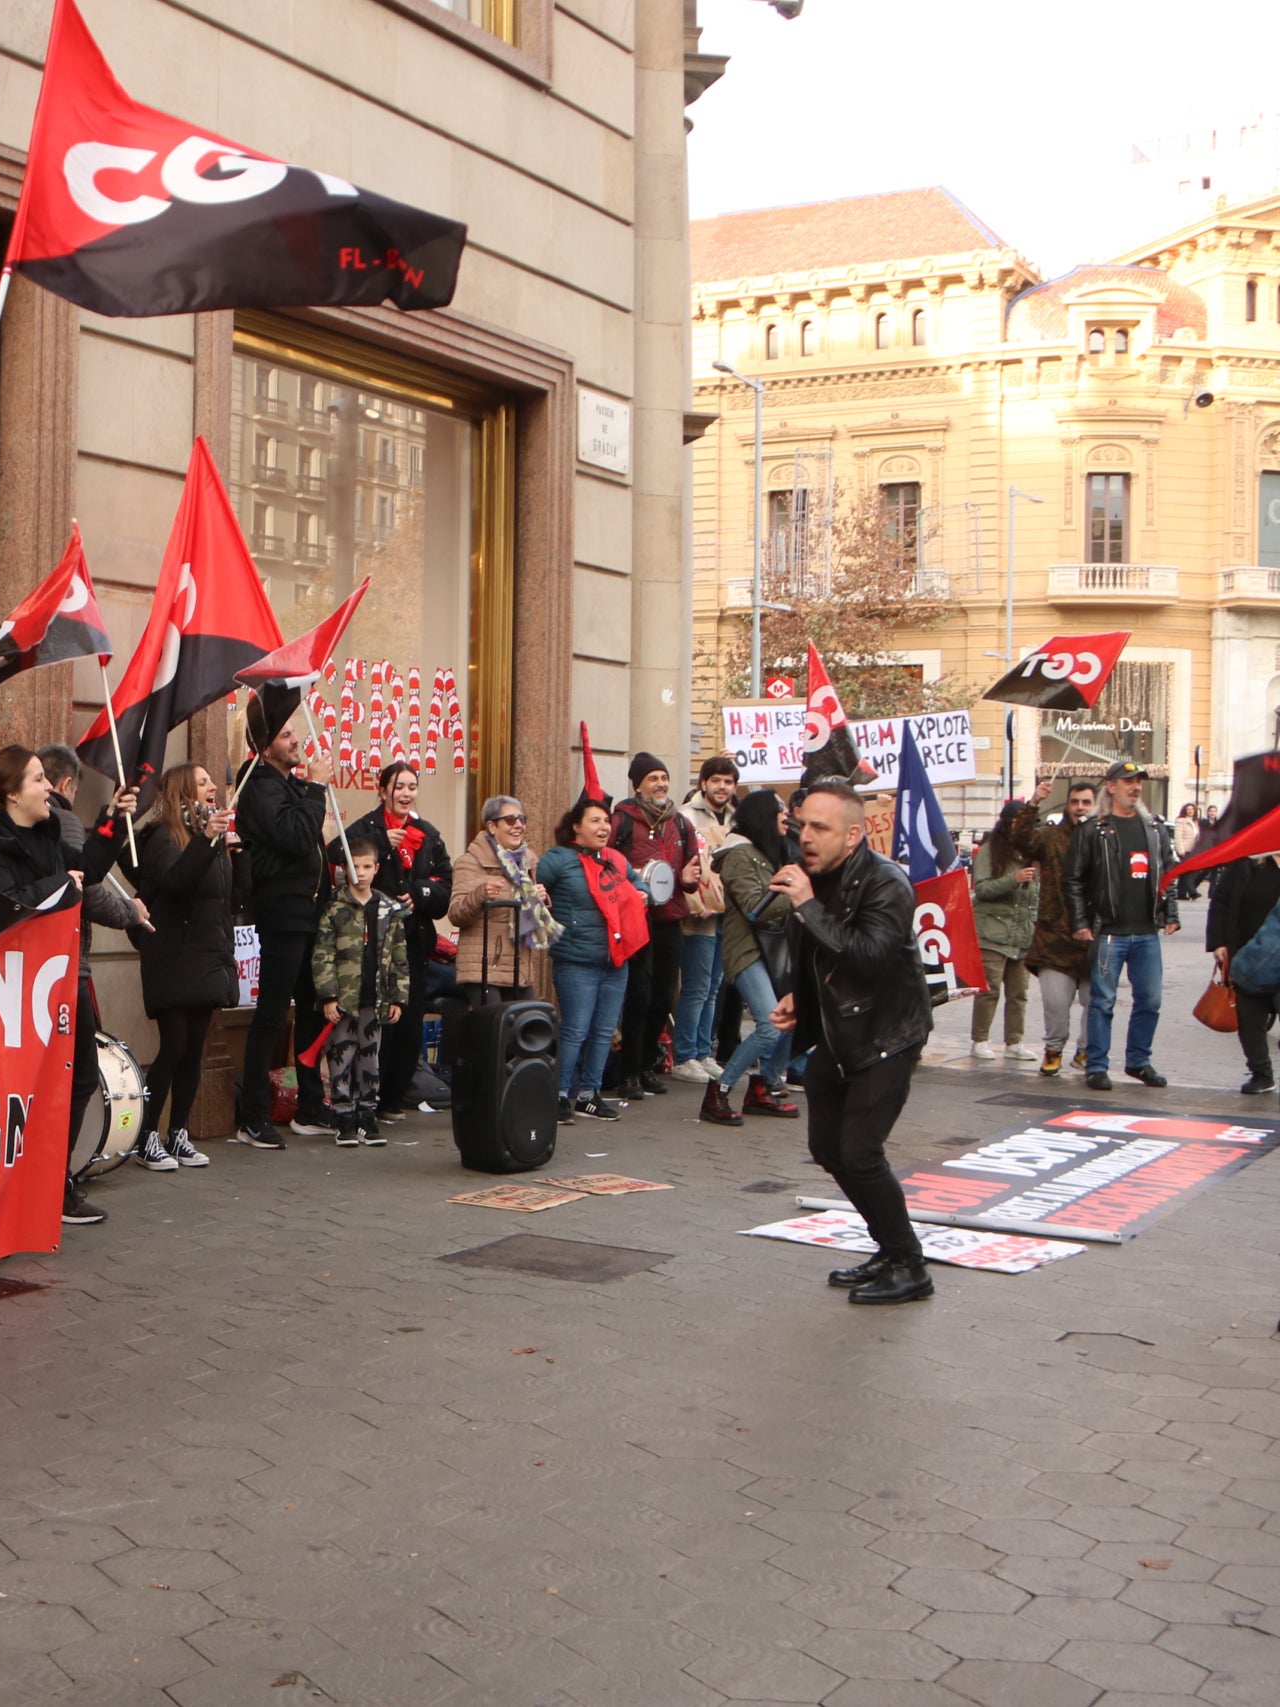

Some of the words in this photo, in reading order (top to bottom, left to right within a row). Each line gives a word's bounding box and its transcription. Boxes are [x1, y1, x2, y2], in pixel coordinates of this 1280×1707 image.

[340, 247, 367, 270] FL
[773, 684, 784, 694] M
[855, 721, 896, 749] H&M
[912, 714, 971, 742] XPLOTA
[1056, 717, 1115, 732] Massimo
[1119, 717, 1152, 732] Dutti
[735, 749, 768, 768] OUR
[912, 902, 958, 990] CGT
[57, 1003, 71, 1036] CGT
[1215, 1125, 1275, 1144] CGT
